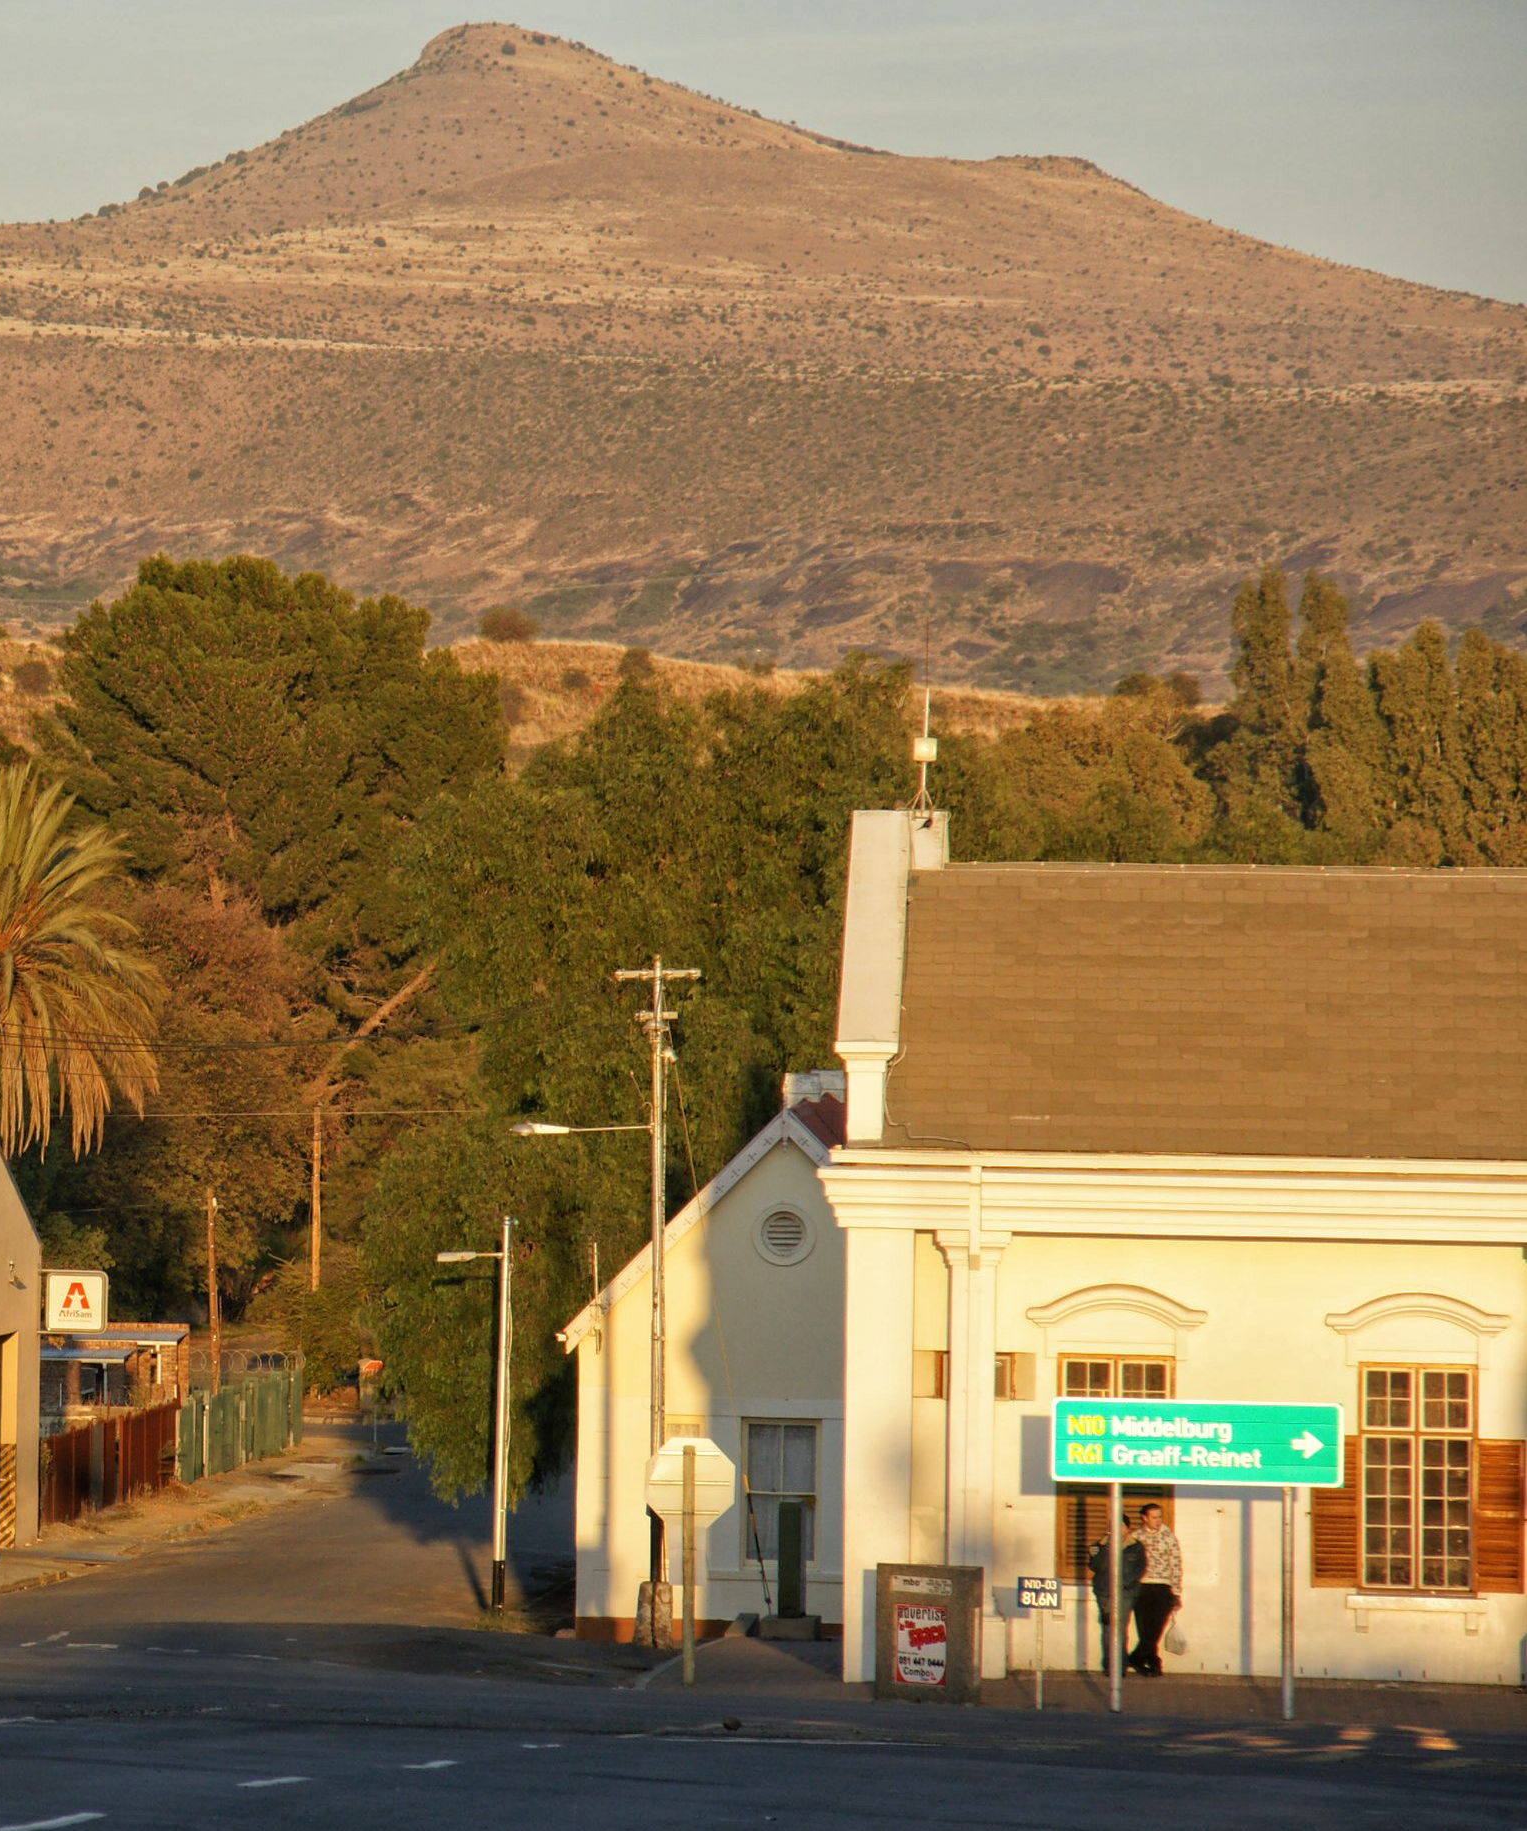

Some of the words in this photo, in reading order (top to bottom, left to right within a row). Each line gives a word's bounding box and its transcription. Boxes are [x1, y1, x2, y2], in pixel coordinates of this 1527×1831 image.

[59, 1310, 93, 1318] AfriSam
[1068, 1415, 1106, 1437] N10
[1111, 1416, 1233, 1443] Middelburg
[1068, 1443, 1103, 1465] R61
[1111, 1445, 1263, 1469] Graaff-Reinet
[1024, 1579, 1057, 1590] N10-03
[898, 1607, 946, 1621] advertise
